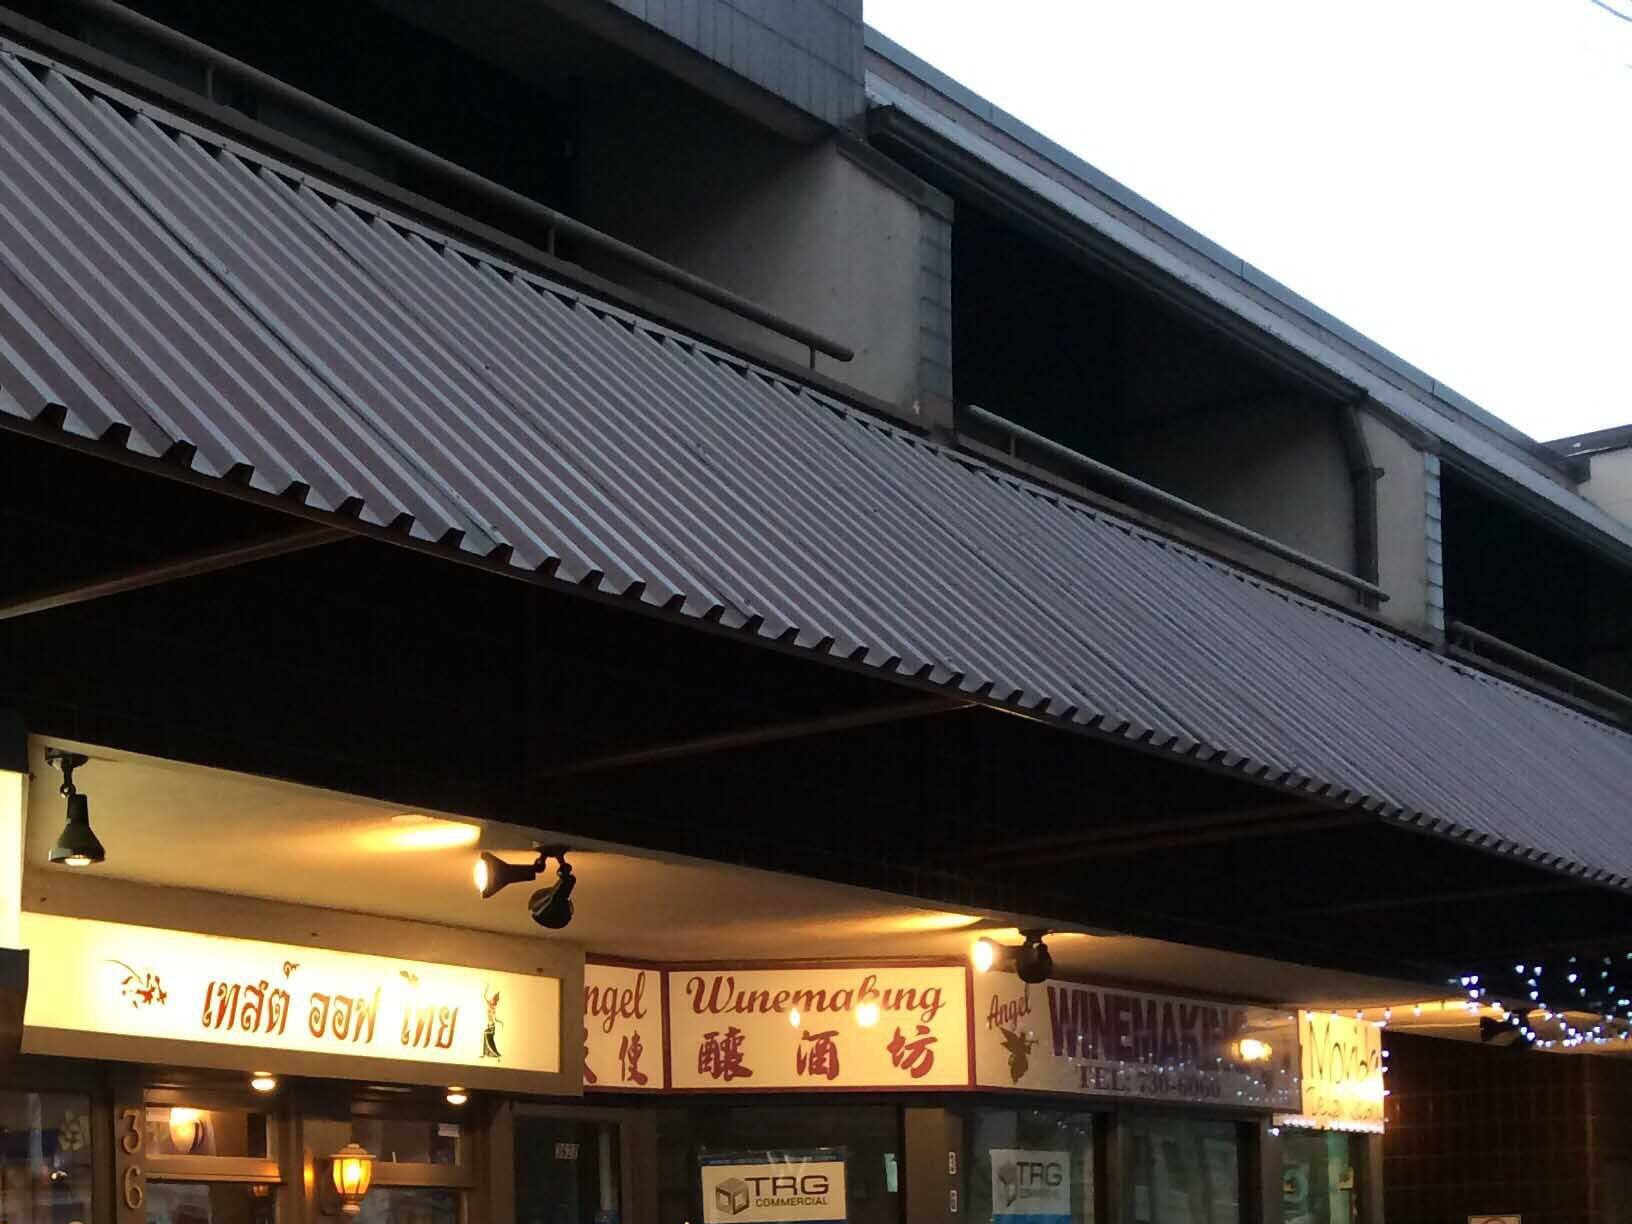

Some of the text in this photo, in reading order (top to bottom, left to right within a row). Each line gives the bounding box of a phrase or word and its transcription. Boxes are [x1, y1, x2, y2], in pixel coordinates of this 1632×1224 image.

[583, 970, 648, 1034] ngel
[686, 974, 947, 1024] Winemaking
[986, 982, 1033, 1030] Angel
[744, 1174, 830, 1197] TRG
[1016, 1161, 1063, 1187] TRG
[755, 1196, 829, 1208] COMMERCIAL
